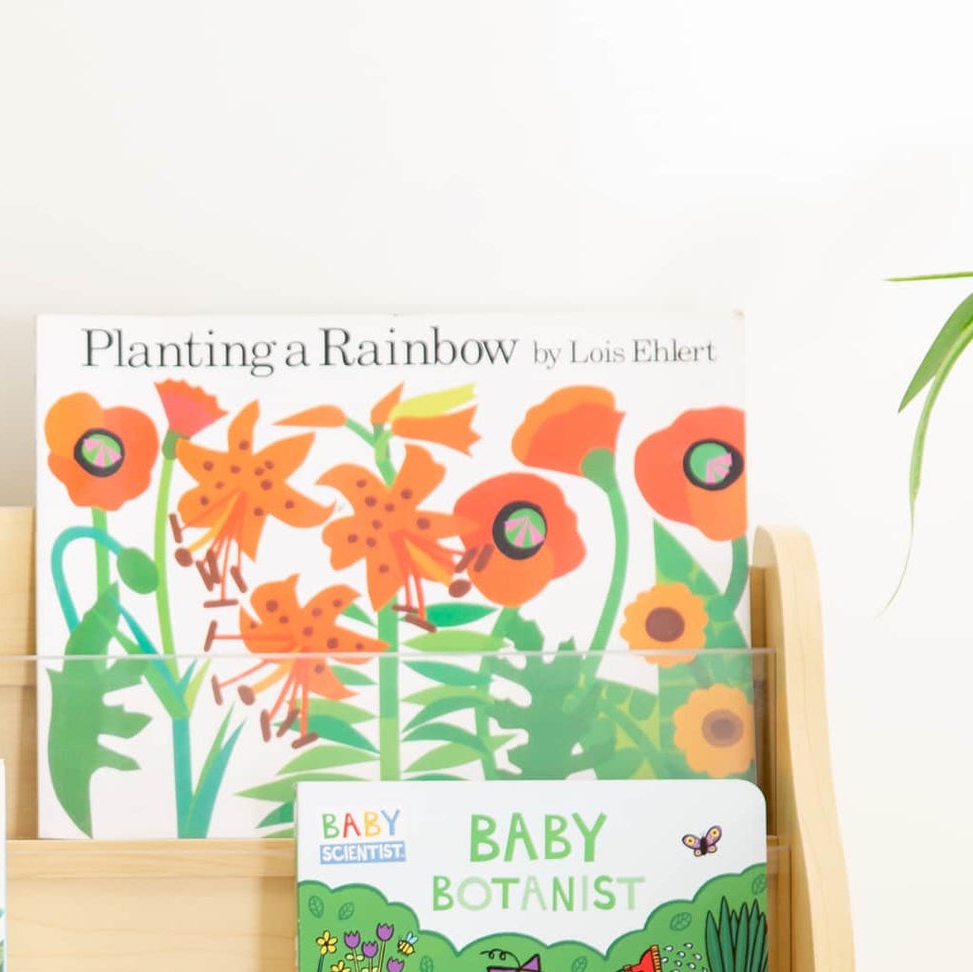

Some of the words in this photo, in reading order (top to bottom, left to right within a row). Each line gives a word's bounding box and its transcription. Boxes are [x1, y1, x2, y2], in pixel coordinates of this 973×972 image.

[81, 328, 277, 377] Planting
[285, 343, 310, 367] a
[319, 328, 518, 367] Rainbow
[533, 341, 561, 369] by
[569, 340, 625, 364] Lois
[632, 339, 717, 364] Ehlert
[322, 808, 401, 840] BABY
[469, 811, 608, 864] BABY
[321, 843, 404, 863] SCIENTIST
[432, 875, 646, 912] BOTANIST
